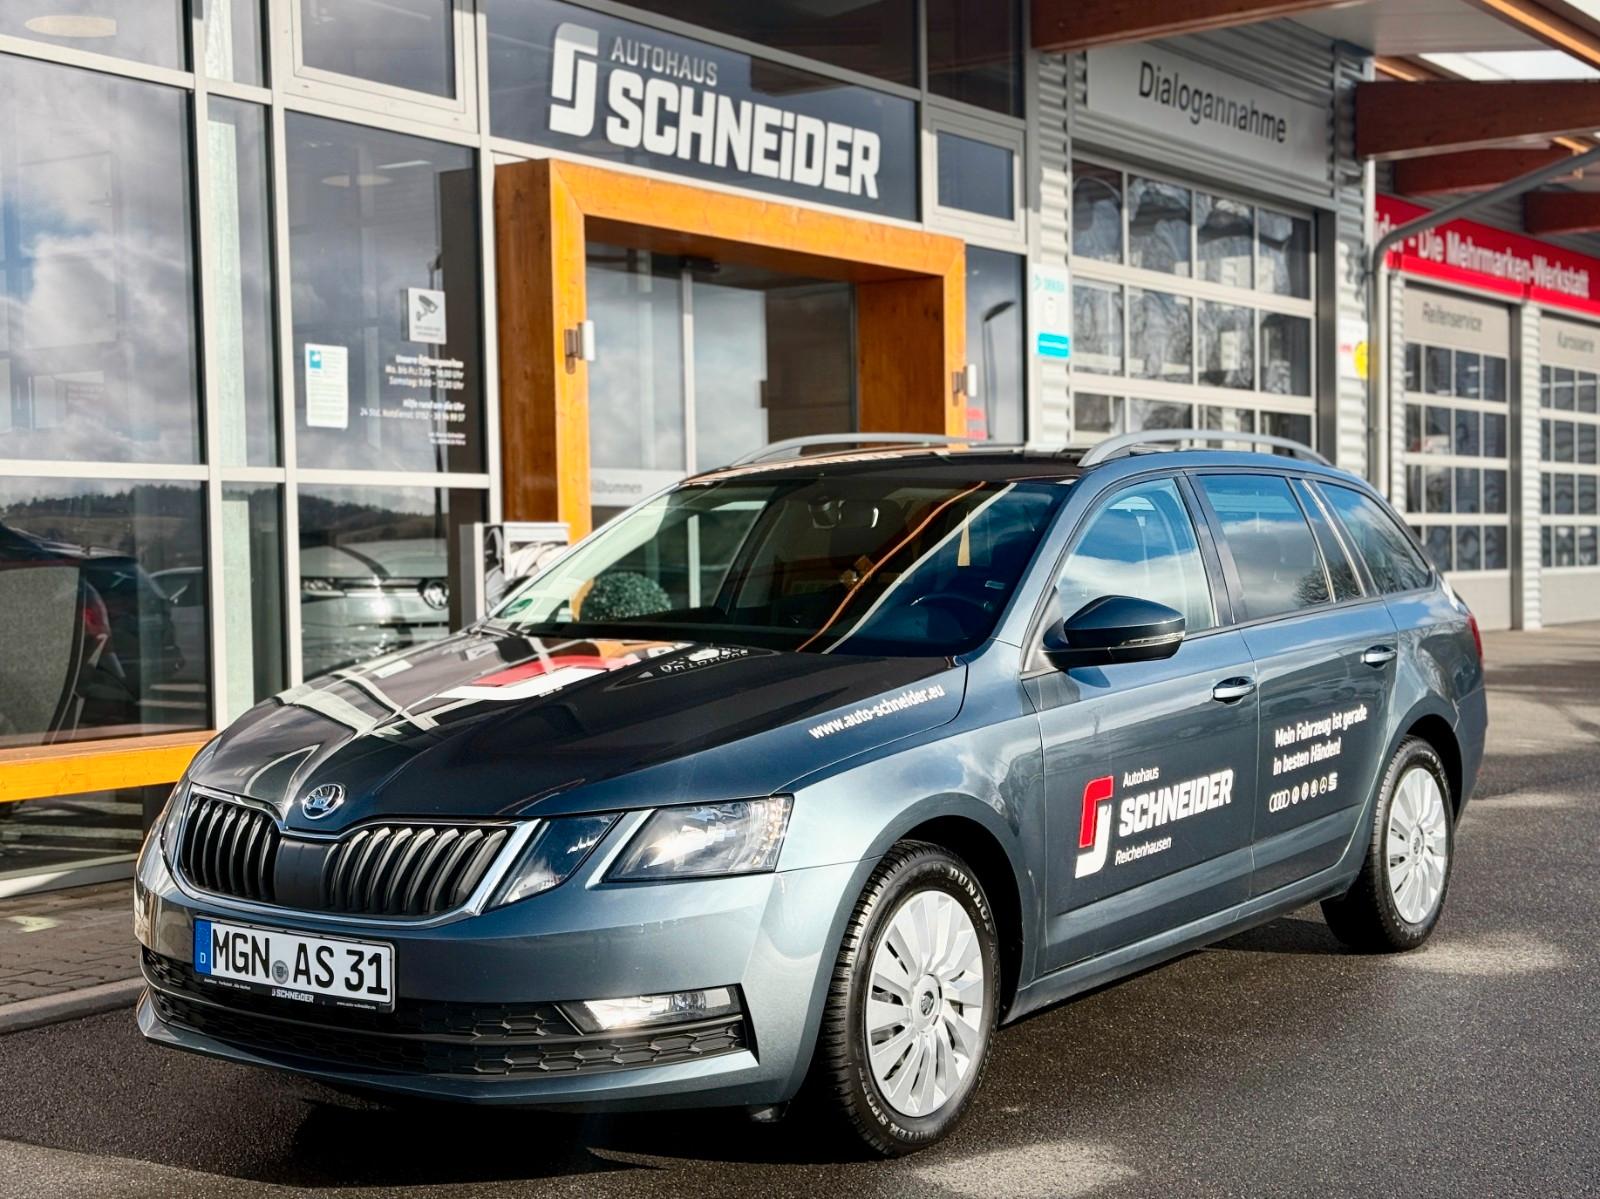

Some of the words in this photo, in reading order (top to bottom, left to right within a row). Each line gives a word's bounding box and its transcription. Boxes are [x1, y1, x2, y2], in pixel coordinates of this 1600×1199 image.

[611, 36, 719, 87] AUTOHAUS
[1139, 60, 1287, 143] Dialogannahme
[1418, 228, 1444, 262] Die
[1446, 230, 1590, 299] Mehrmarken-Werkstatt
[1421, 302, 1483, 333] Reifenservice
[808, 684, 946, 739] www.auto-schneider.eu
[1275, 725, 1296, 748] Mein
[1296, 716, 1331, 741] Fahrzeug
[1331, 711, 1342, 731] ist
[1342, 704, 1368, 728] gerade
[1122, 766, 1160, 788] Autohaus
[1273, 755, 1282, 776] in
[1282, 748, 1310, 773] besten
[1310, 737, 1341, 763] Händen!
[1118, 768, 1235, 838] SCHNEIDER
[1114, 836, 1172, 867] Reichenhausen
[200, 952, 207, 965] D
[212, 928, 270, 979] MGN
[293, 942, 335, 989] AS
[344, 949, 388, 996] 31
